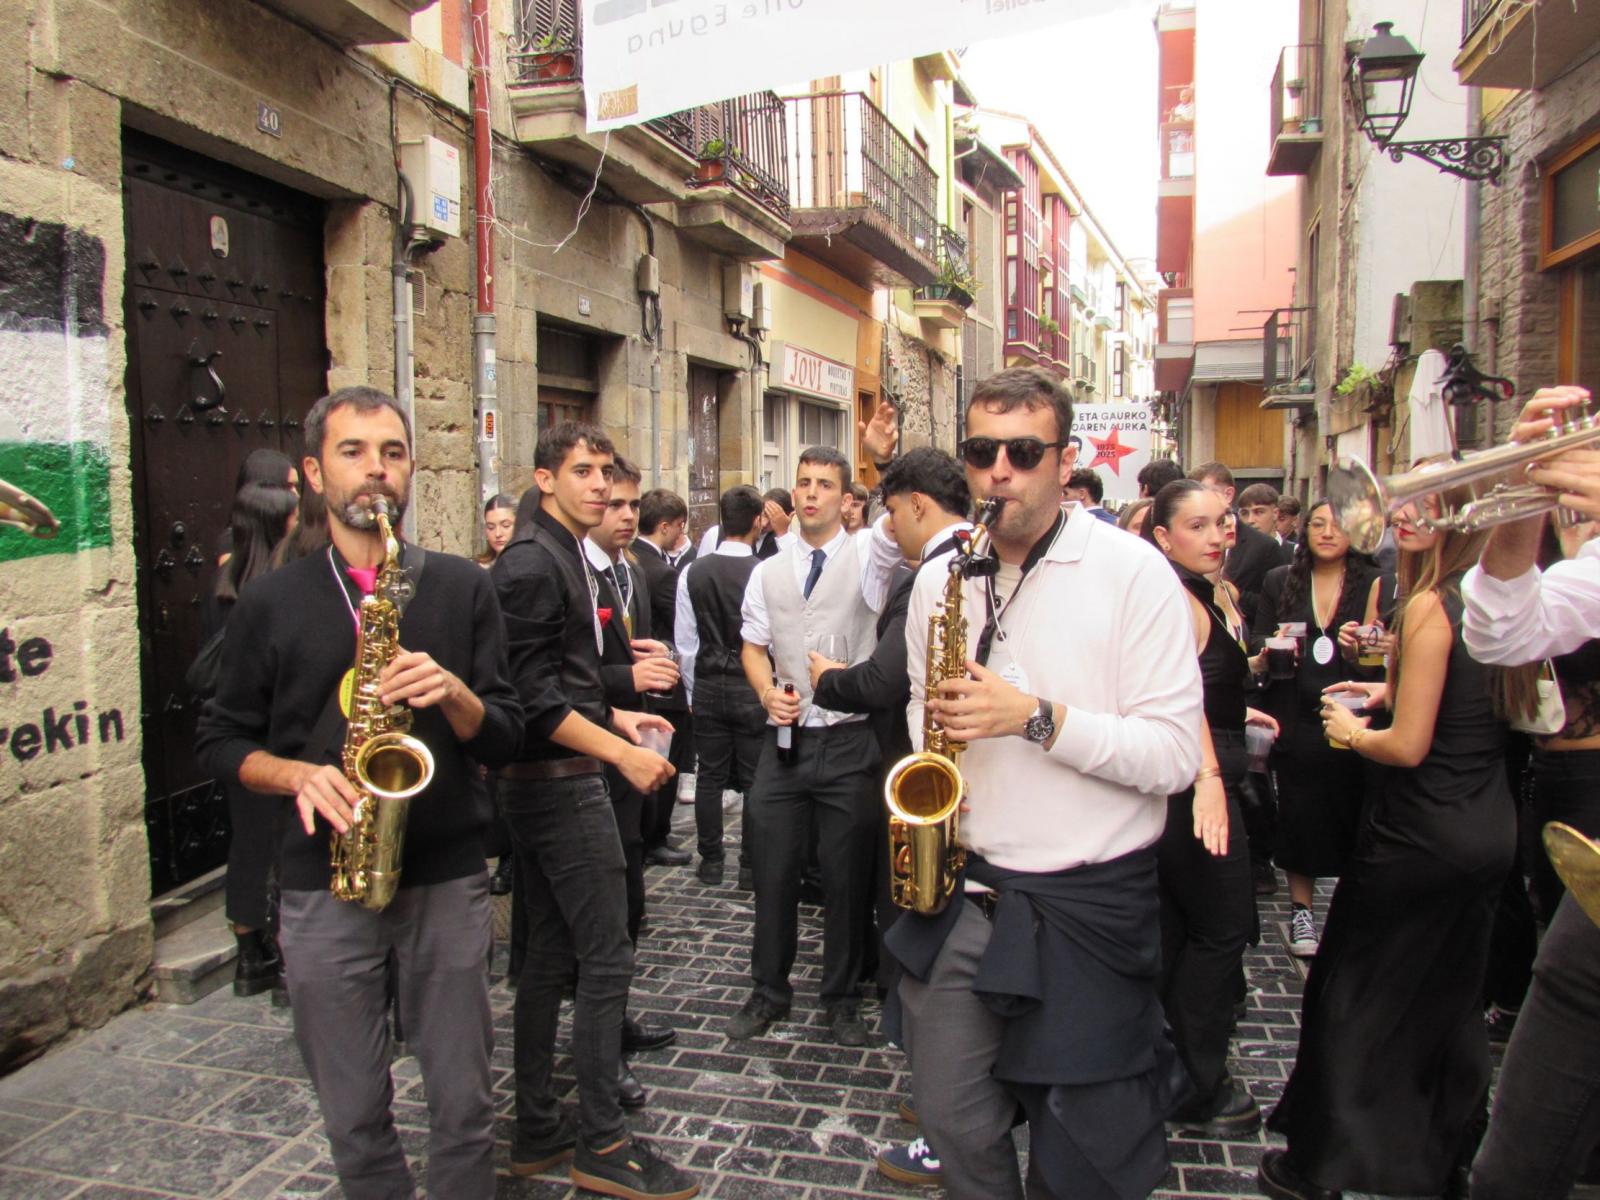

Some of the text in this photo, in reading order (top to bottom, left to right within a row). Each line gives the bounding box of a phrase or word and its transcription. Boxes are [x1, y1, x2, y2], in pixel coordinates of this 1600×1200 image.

[260, 107, 279, 131] 40
[790, 351, 822, 391] JOVI
[1079, 411, 1147, 422] ETA GAURKO
[1110, 422, 1147, 431] AURKA
[1096, 450, 1116, 458] 2025
